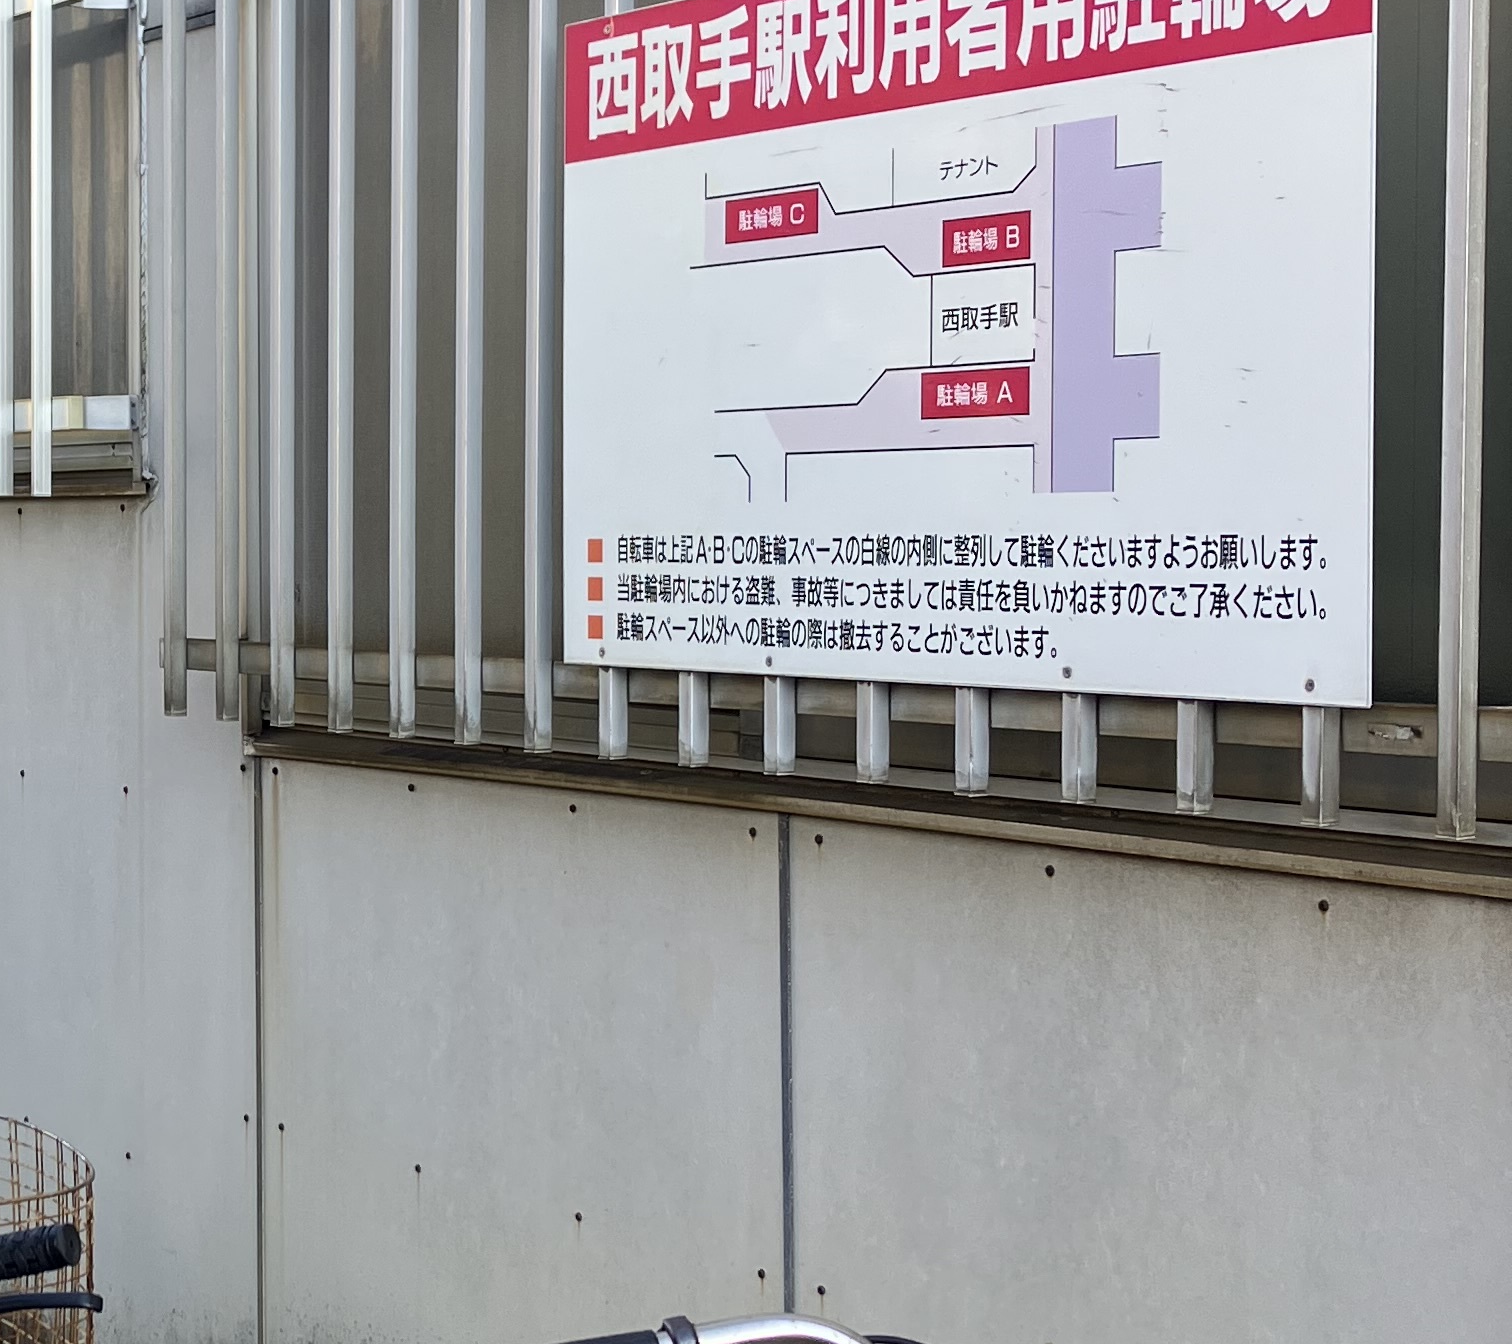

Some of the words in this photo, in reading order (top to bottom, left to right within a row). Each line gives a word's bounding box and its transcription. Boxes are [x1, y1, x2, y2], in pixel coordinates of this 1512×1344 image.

[939, 155, 999, 181] テナント
[737, 204, 783, 232] 駐輪場
[789, 202, 805, 225] C
[952, 226, 998, 254] 駐輪場
[1005, 224, 1020, 249] B
[941, 301, 1019, 333] 西取手駅
[936, 381, 988, 407] 駐輪場
[996, 380, 1013, 404] A
[616, 574, 1328, 620] 当駐輪場内における盗難、事故等につきましては責任を負いかねますのでご了承ください。
[616, 612, 1058, 660] 駐輪スペース以外への駐輪の際は撤去することがございます。
